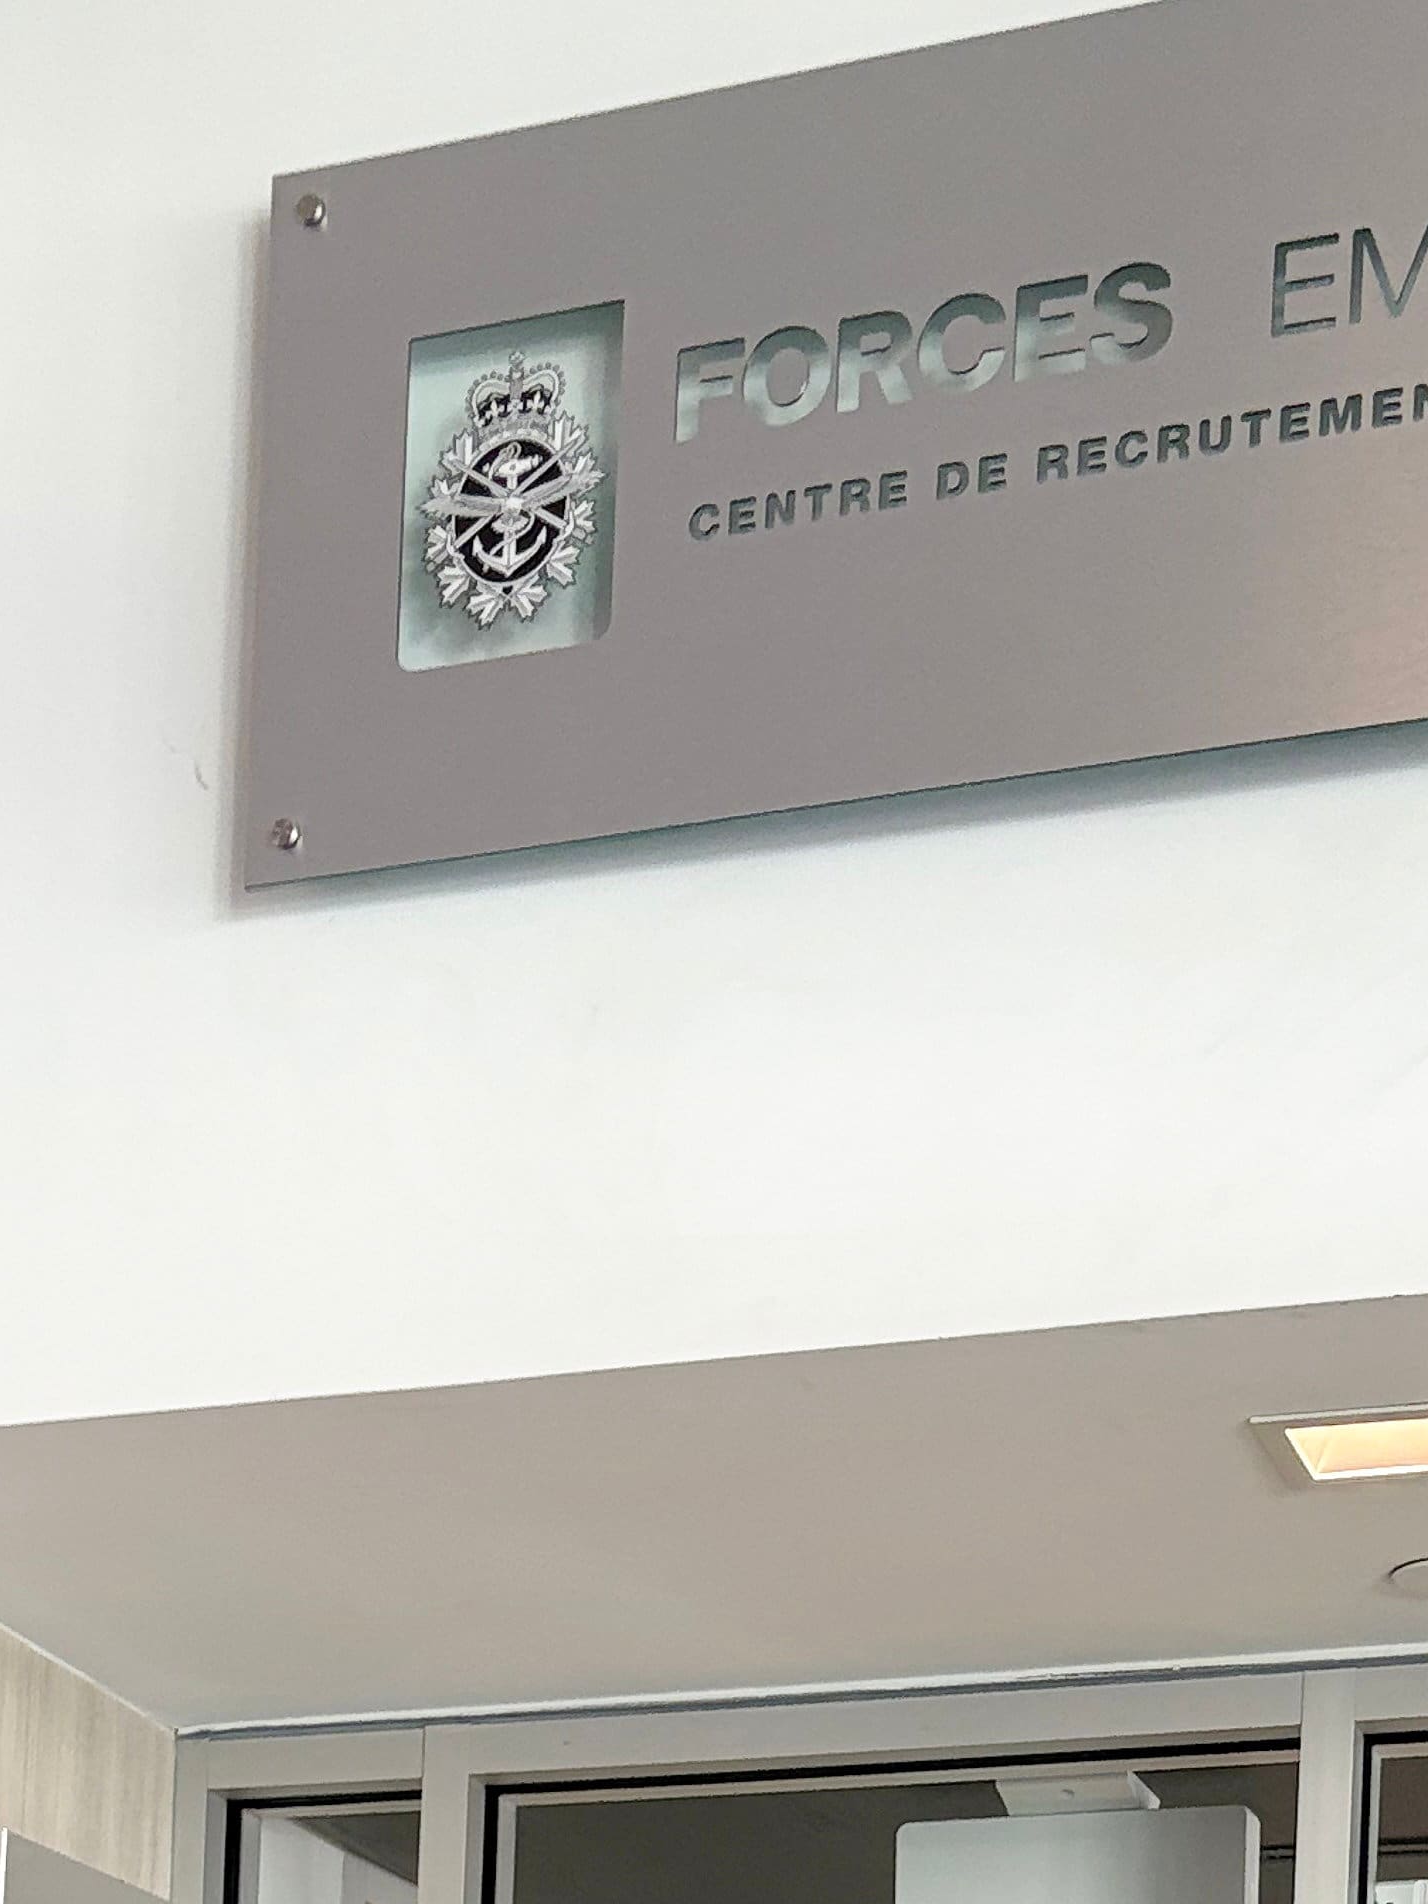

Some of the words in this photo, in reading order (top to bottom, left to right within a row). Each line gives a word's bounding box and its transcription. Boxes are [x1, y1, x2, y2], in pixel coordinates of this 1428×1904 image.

[674, 262, 1173, 444] FORCES
[687, 470, 908, 541] CENTRE
[935, 453, 1008, 493] DE
